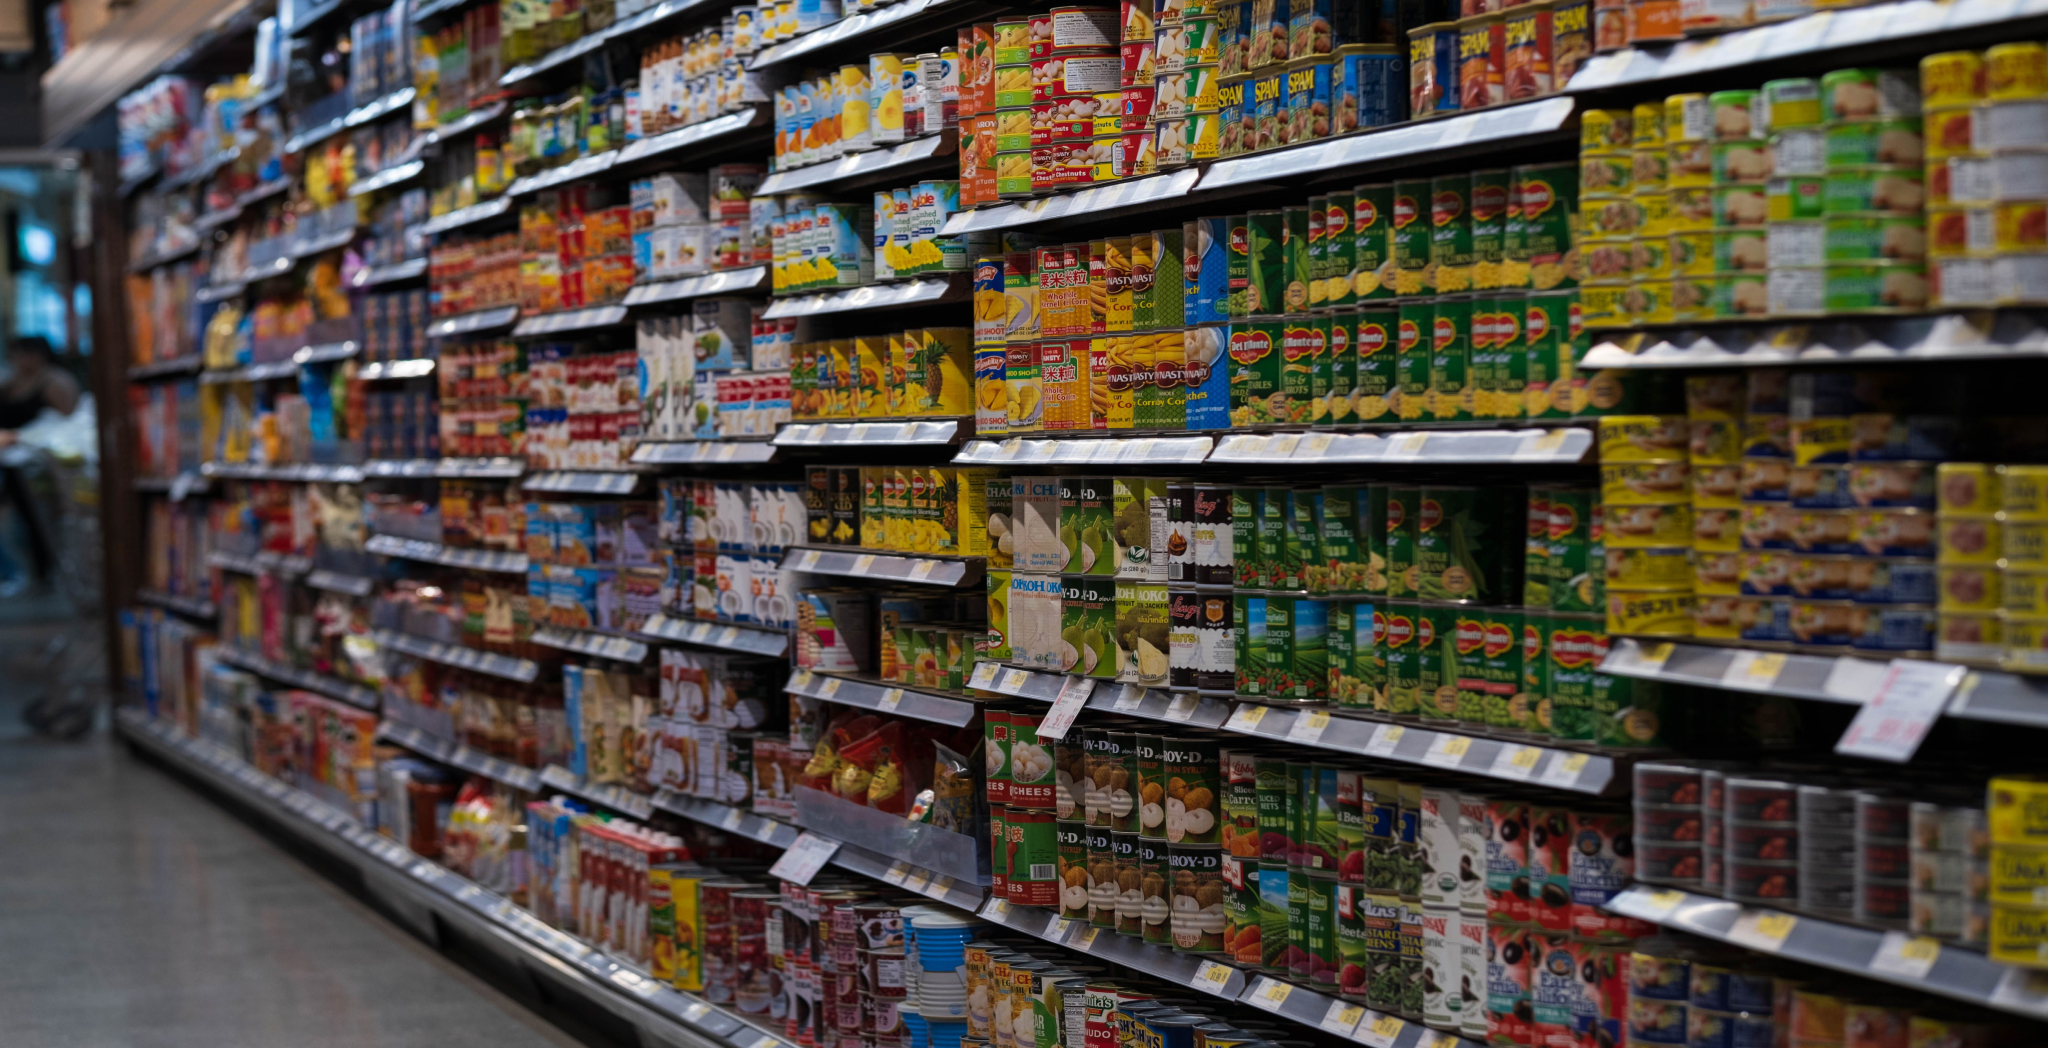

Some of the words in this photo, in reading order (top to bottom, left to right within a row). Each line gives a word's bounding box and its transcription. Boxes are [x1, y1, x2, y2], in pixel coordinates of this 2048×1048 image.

[1553, 4, 1588, 35] SPAM
[1255, 78, 1280, 101] SPAM
[1288, 69, 1315, 94] SPAM
[1218, 85, 1244, 108] SPAM
